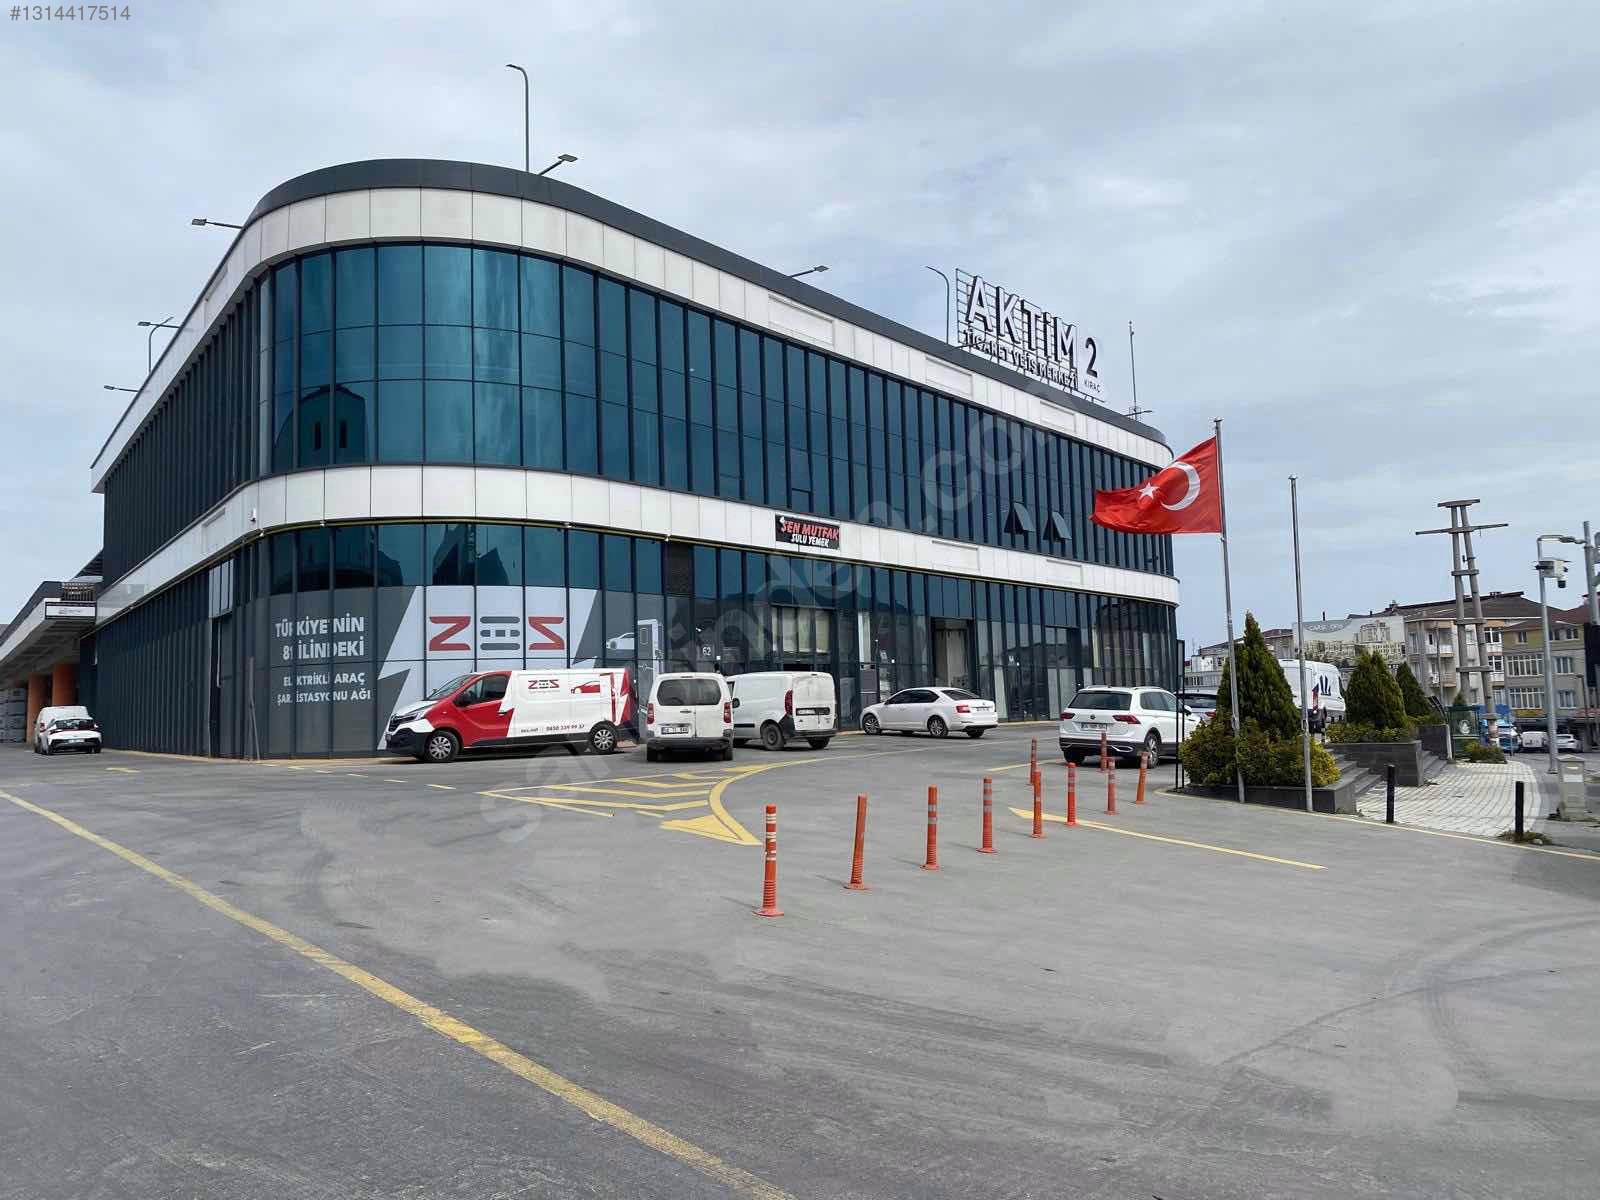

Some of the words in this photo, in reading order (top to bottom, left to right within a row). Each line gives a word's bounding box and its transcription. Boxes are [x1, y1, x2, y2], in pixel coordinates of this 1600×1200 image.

[1085, 337, 1098, 378] 2
[802, 523, 839, 541] MUTFAK
[791, 533, 808, 545] SULU
[808, 536, 830, 548] YEMEK
[283, 672, 331, 686] ELKTRİKLİ
[334, 672, 366, 686] ARAÇ
[350, 687, 371, 701] AĞI
